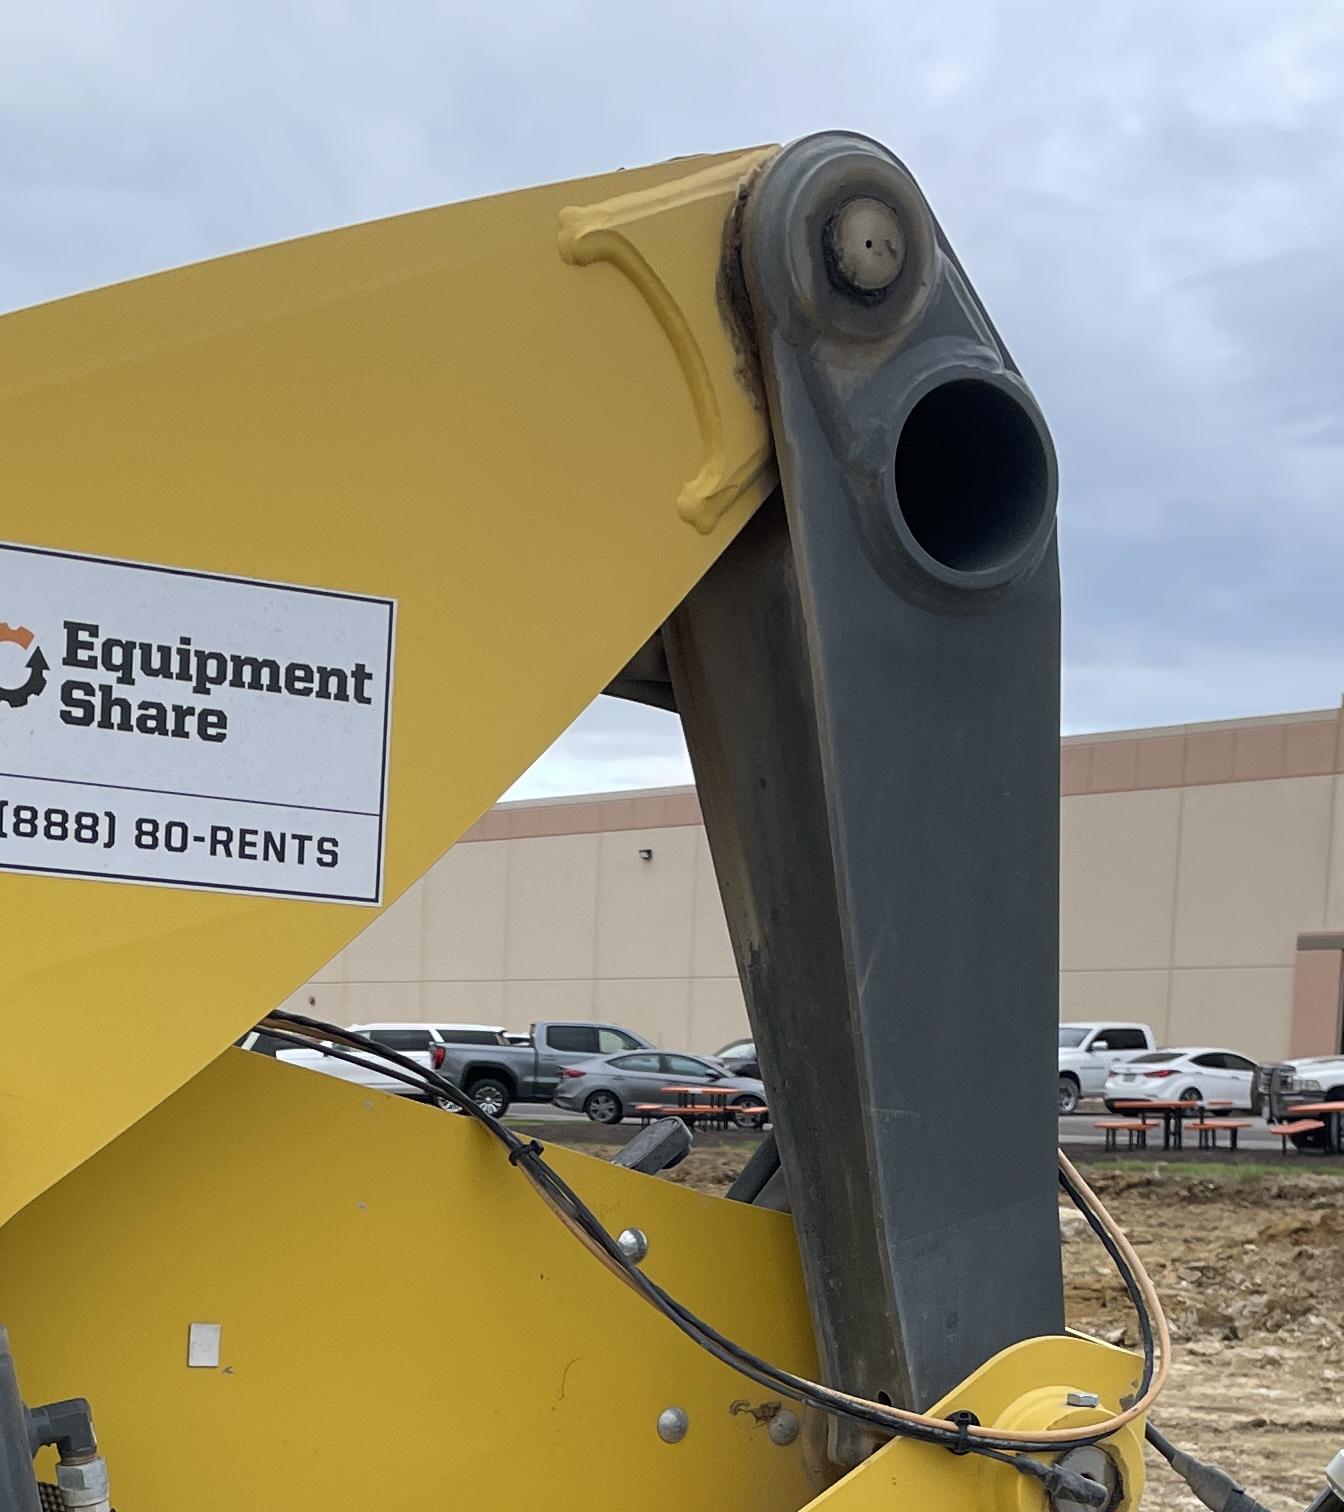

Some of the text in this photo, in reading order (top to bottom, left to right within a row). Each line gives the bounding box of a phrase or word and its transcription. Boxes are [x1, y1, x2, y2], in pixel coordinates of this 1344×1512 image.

[61, 620, 373, 705] Equipment
[59, 679, 228, 743] Share
[134, 818, 340, 868] 80-RENTS
